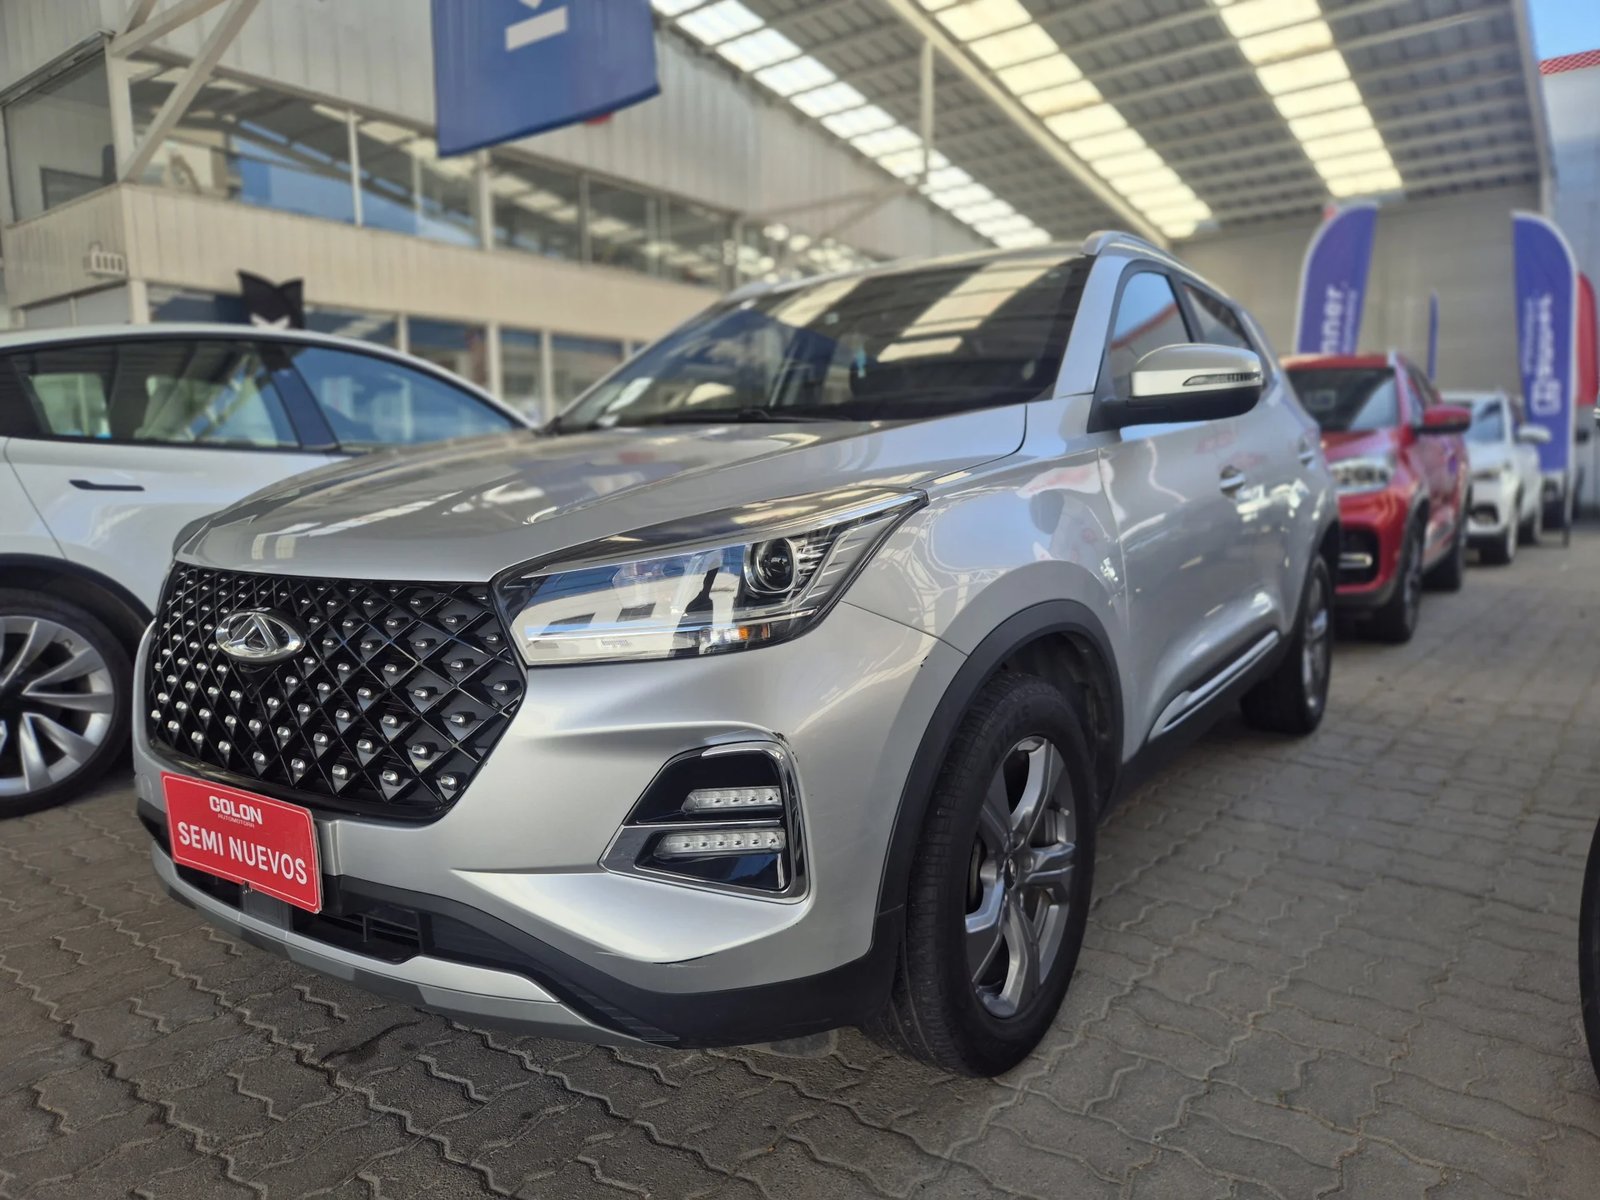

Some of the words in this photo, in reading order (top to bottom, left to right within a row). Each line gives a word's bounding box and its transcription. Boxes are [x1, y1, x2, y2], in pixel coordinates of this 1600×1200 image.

[209, 796, 263, 824] COLON
[178, 822, 223, 856] SEMI
[229, 837, 307, 884] NUEVOS
